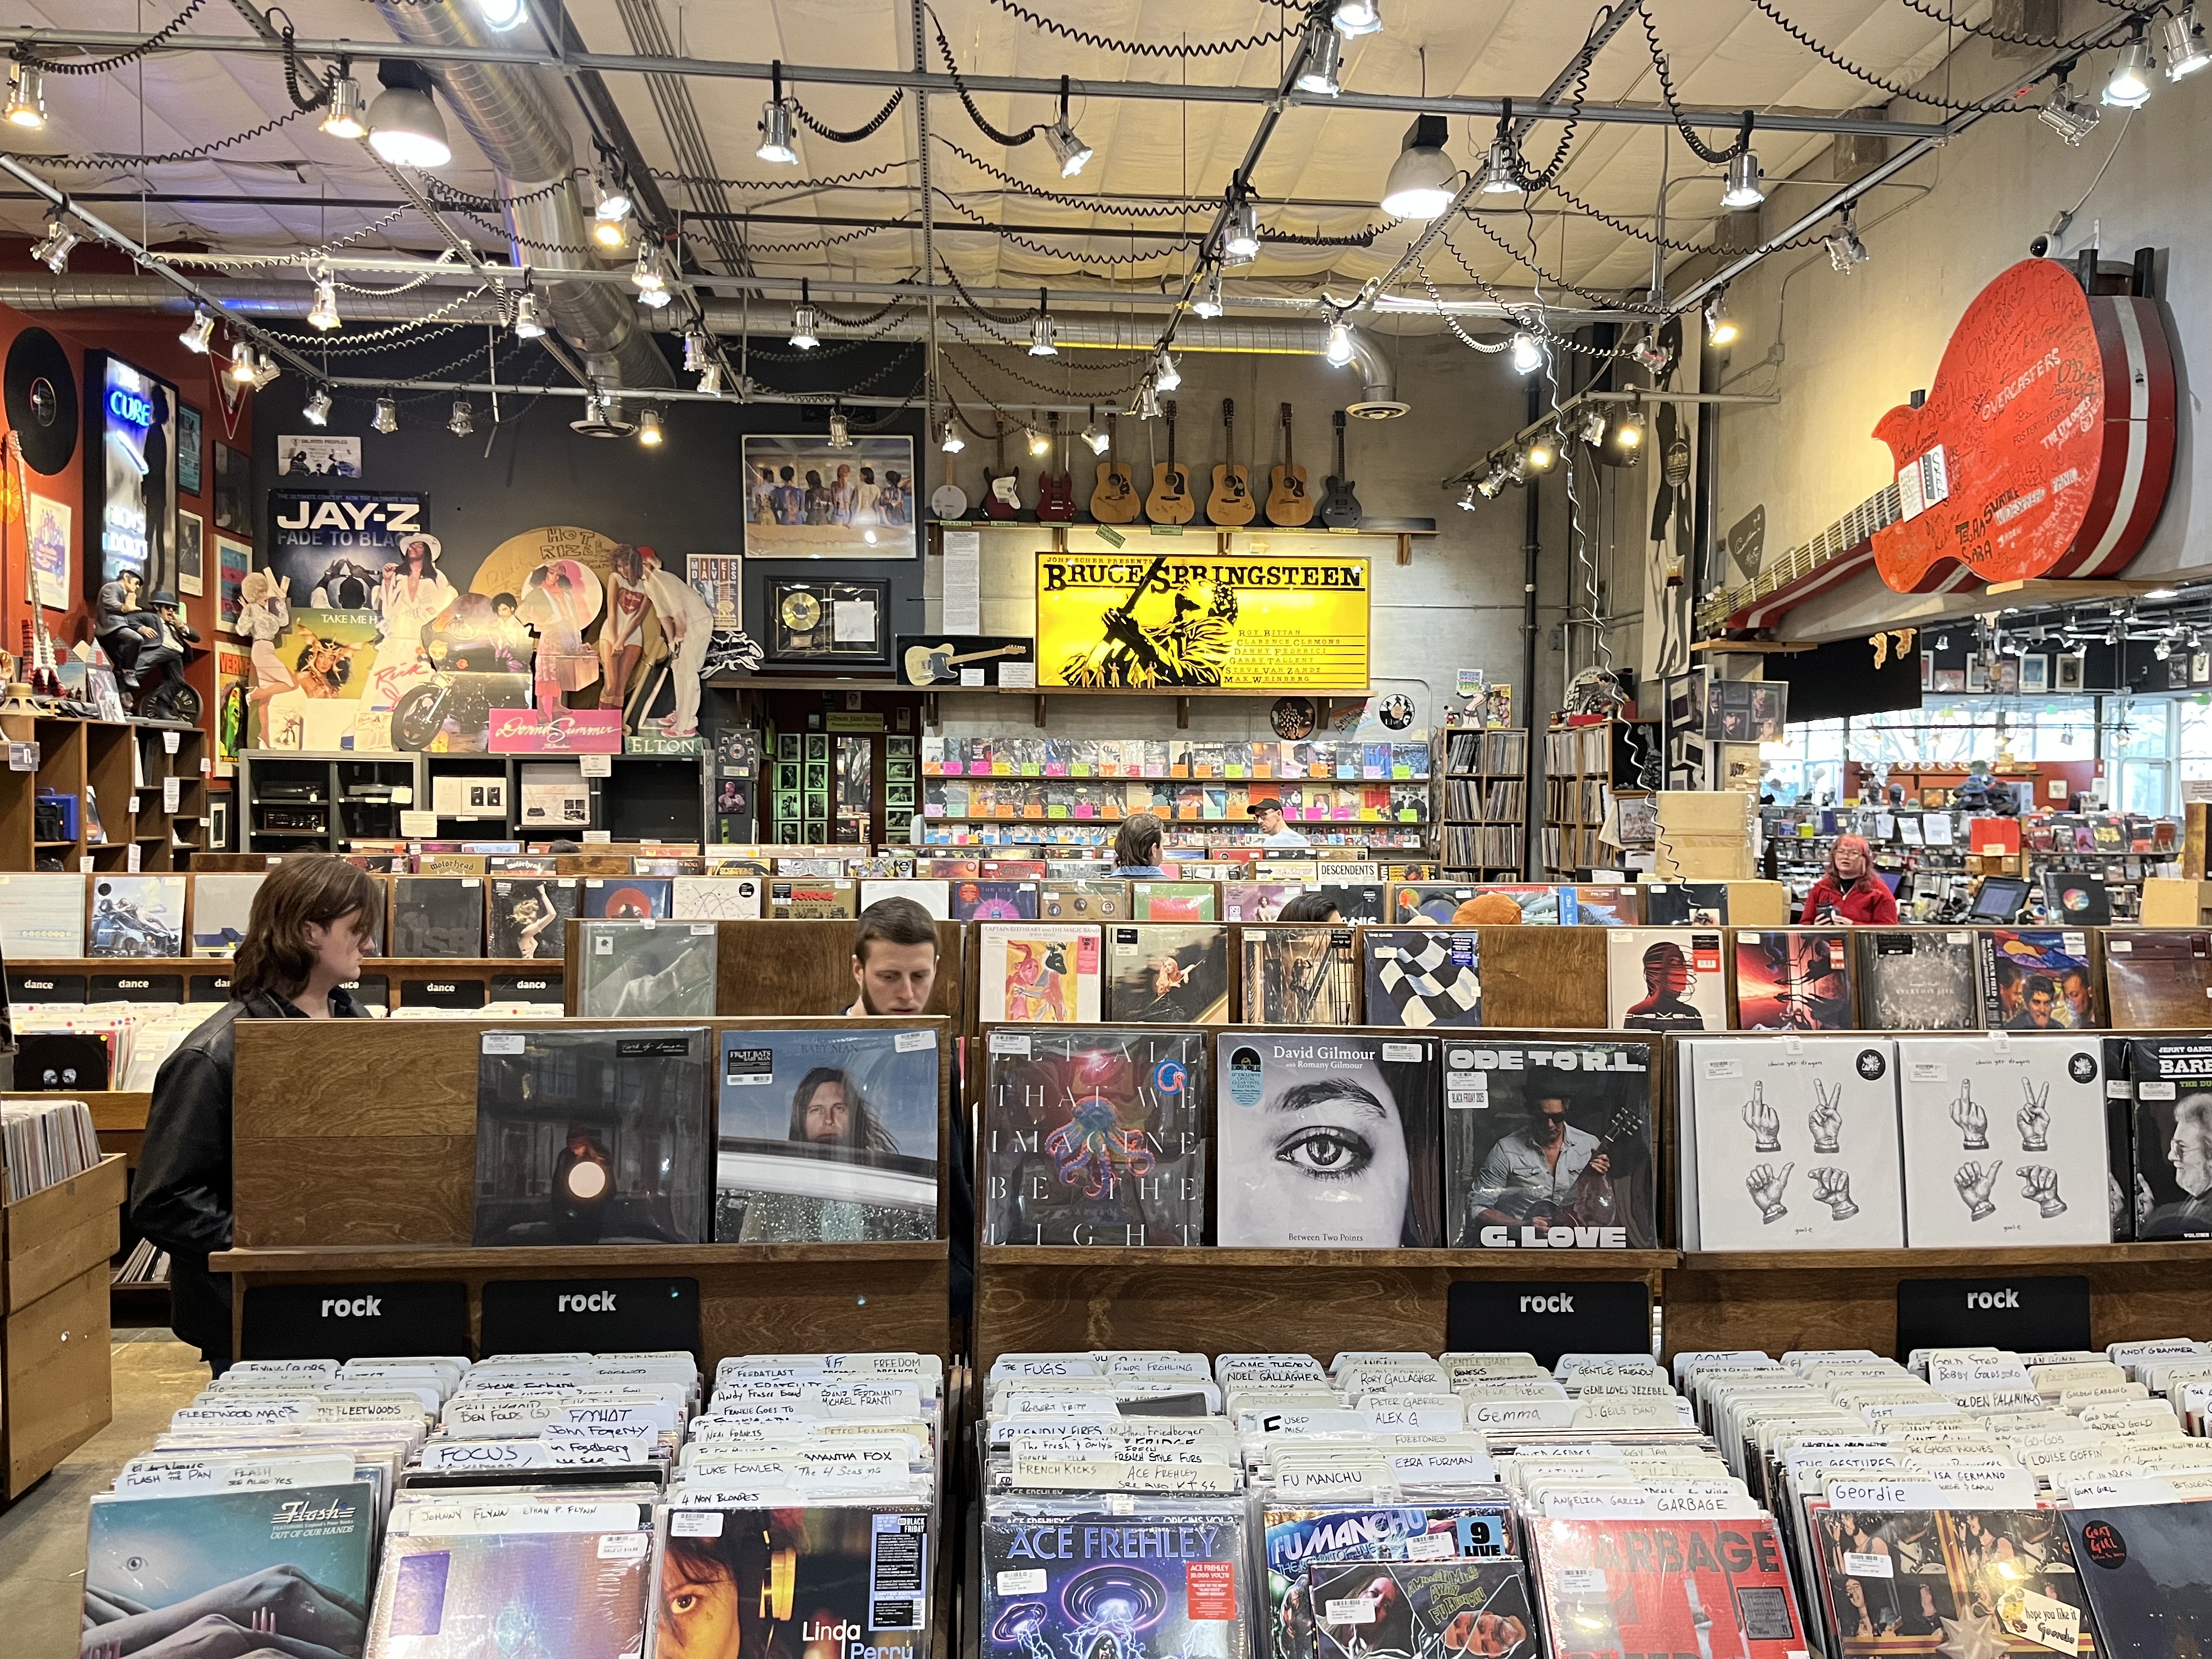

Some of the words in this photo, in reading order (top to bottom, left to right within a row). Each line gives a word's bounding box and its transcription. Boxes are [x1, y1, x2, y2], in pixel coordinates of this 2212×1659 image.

[1982, 347, 2061, 422] OVERCASTERS
[2051, 468, 2078, 492] PANIC
[277, 501, 420, 532] JAY-Z
[278, 531, 323, 545] FADE
[330, 532, 353, 546] TO
[547, 528, 595, 545] HOT
[540, 544, 593, 560] RIZE
[691, 561, 737, 571] MILES
[692, 571, 737, 579] DAVIS
[1043, 563, 1143, 591] BRUCE
[1151, 565, 1364, 594] SPRINGSTEEN
[321, 614, 348, 624] TAKE
[350, 615, 367, 624] ME
[631, 737, 696, 754] ELTON
[1322, 865, 1374, 875] DESCENDENTS
[24, 979, 54, 989] dance
[119, 979, 149, 989] dance
[427, 983, 455, 993] dance
[517, 980, 546, 990] dance
[1273, 1046, 1313, 1059] David
[1317, 1046, 1375, 1060] Gilmour
[1297, 1060, 1329, 1070] Romany
[1331, 1061, 1363, 1069] Gilmour
[1449, 1049, 1523, 1070] ODE
[1528, 1051, 1578, 1071] TO
[1583, 1051, 1646, 1072] R.L.
[992, 1085, 1107, 1107] THAT
[1137, 1086, 1196, 1109] WE
[992, 1130, 1196, 1154] IMAGINE
[991, 1176, 1048, 1199] BE
[1102, 1177, 1196, 1200] THE
[990, 1223, 1196, 1246] LIGHT
[1288, 1233, 1320, 1242] Between
[1480, 1226, 1516, 1247] G.
[1521, 1226, 1626, 1248] LOVE
[558, 1290, 617, 1312] rock
[1520, 1293, 1574, 1312] rock
[1967, 1288, 2019, 1309] rock
[321, 1295, 382, 1317] rock
[2120, 1347, 2145, 1356] ANDY
[873, 1358, 921, 1368] FREEDOM
[1024, 1363, 1067, 1375] FUGS
[1227, 1372, 1254, 1382] NOEL
[1260, 1373, 1323, 1382] GALLAGHER
[1578, 1367, 1614, 1375] GENTLE
[1939, 1368, 1968, 1381] BOBBY
[1361, 1373, 1383, 1384] RORY
[1385, 1373, 1437, 1383] GALLAGHER
[1632, 1387, 1668, 1395] JEZEBEL
[822, 1397, 856, 1407] MICHAEL
[860, 1397, 891, 1406] FRANTI
[1370, 1398, 1401, 1408] PETER
[1403, 1398, 1444, 1407] GABRIEL
[178, 1409, 252, 1419] FLEETWOOD
[256, 1410, 285, 1419] MAC
[337, 1404, 402, 1417] FLEETWOODS
[461, 1411, 485, 1422] BEN
[724, 1406, 754, 1415] FRANKIE
[756, 1405, 777, 1414] GOES
[1477, 1407, 1541, 1422] Gemma
[1600, 1406, 1626, 1417] GEILS
[1376, 1412, 1403, 1424] ALEX
[2128, 1419, 2153, 1427] GOLD
[546, 1425, 584, 1435] John
[1396, 1435, 1447, 1444] FUZZTONES
[864, 1452, 892, 1461] FOX
[1149, 1452, 1173, 1462] STYLE
[1180, 1453, 1202, 1463] FURS
[1395, 1457, 1424, 1468] EZRA
[1429, 1456, 1473, 1467] FURMAN
[2031, 1452, 2066, 1465] LOUISE
[2070, 1449, 2103, 1462] GOFFIN
[234, 1468, 271, 1477] FLASH
[698, 1464, 727, 1476] LUKE
[734, 1463, 784, 1474] FOWLER
[823, 1466, 833, 1477] 4
[1019, 1463, 1061, 1476] FRENCH
[1064, 1464, 1097, 1475] KICKS
[1127, 1468, 1150, 1479] ACE
[1155, 1469, 1198, 1481] FREHLEY
[127, 1472, 160, 1486] FLASH
[188, 1469, 211, 1480] PAN
[1283, 1474, 1300, 1487] FU
[1306, 1471, 1362, 1485] MANCHU
[682, 1494, 690, 1505] 4
[694, 1494, 712, 1504] NON
[718, 1493, 760, 1503] BLONDES
[1836, 1486, 1905, 1502] Geordie
[1553, 1496, 1602, 1506] ANGELICA
[1610, 1496, 1645, 1506] GARCIA
[1657, 1498, 1728, 1511] GARBAGE
[421, 1511, 462, 1521] JOHNNY
[473, 1508, 509, 1520] FLYNN
[270, 1530, 287, 1539] OUT
[289, 1530, 302, 1538] OF
[303, 1528, 322, 1537] OUR
[323, 1525, 354, 1536] HANDS
[1273, 1534, 1302, 1565] FU
[1302, 1510, 1425, 1557] MANCHU
[1469, 1521, 1491, 1544] 9
[1007, 1527, 1074, 1559] ACE
[1085, 1527, 1219, 1559] FREHLEY
[1464, 1544, 1502, 1557] LIVE
[1428, 1604, 1449, 1626] FU
[2043, 1611, 2055, 1622] you
[2056, 1608, 2069, 1620] like
[2070, 1608, 2077, 1620] it
[803, 1619, 861, 1646] Linda
